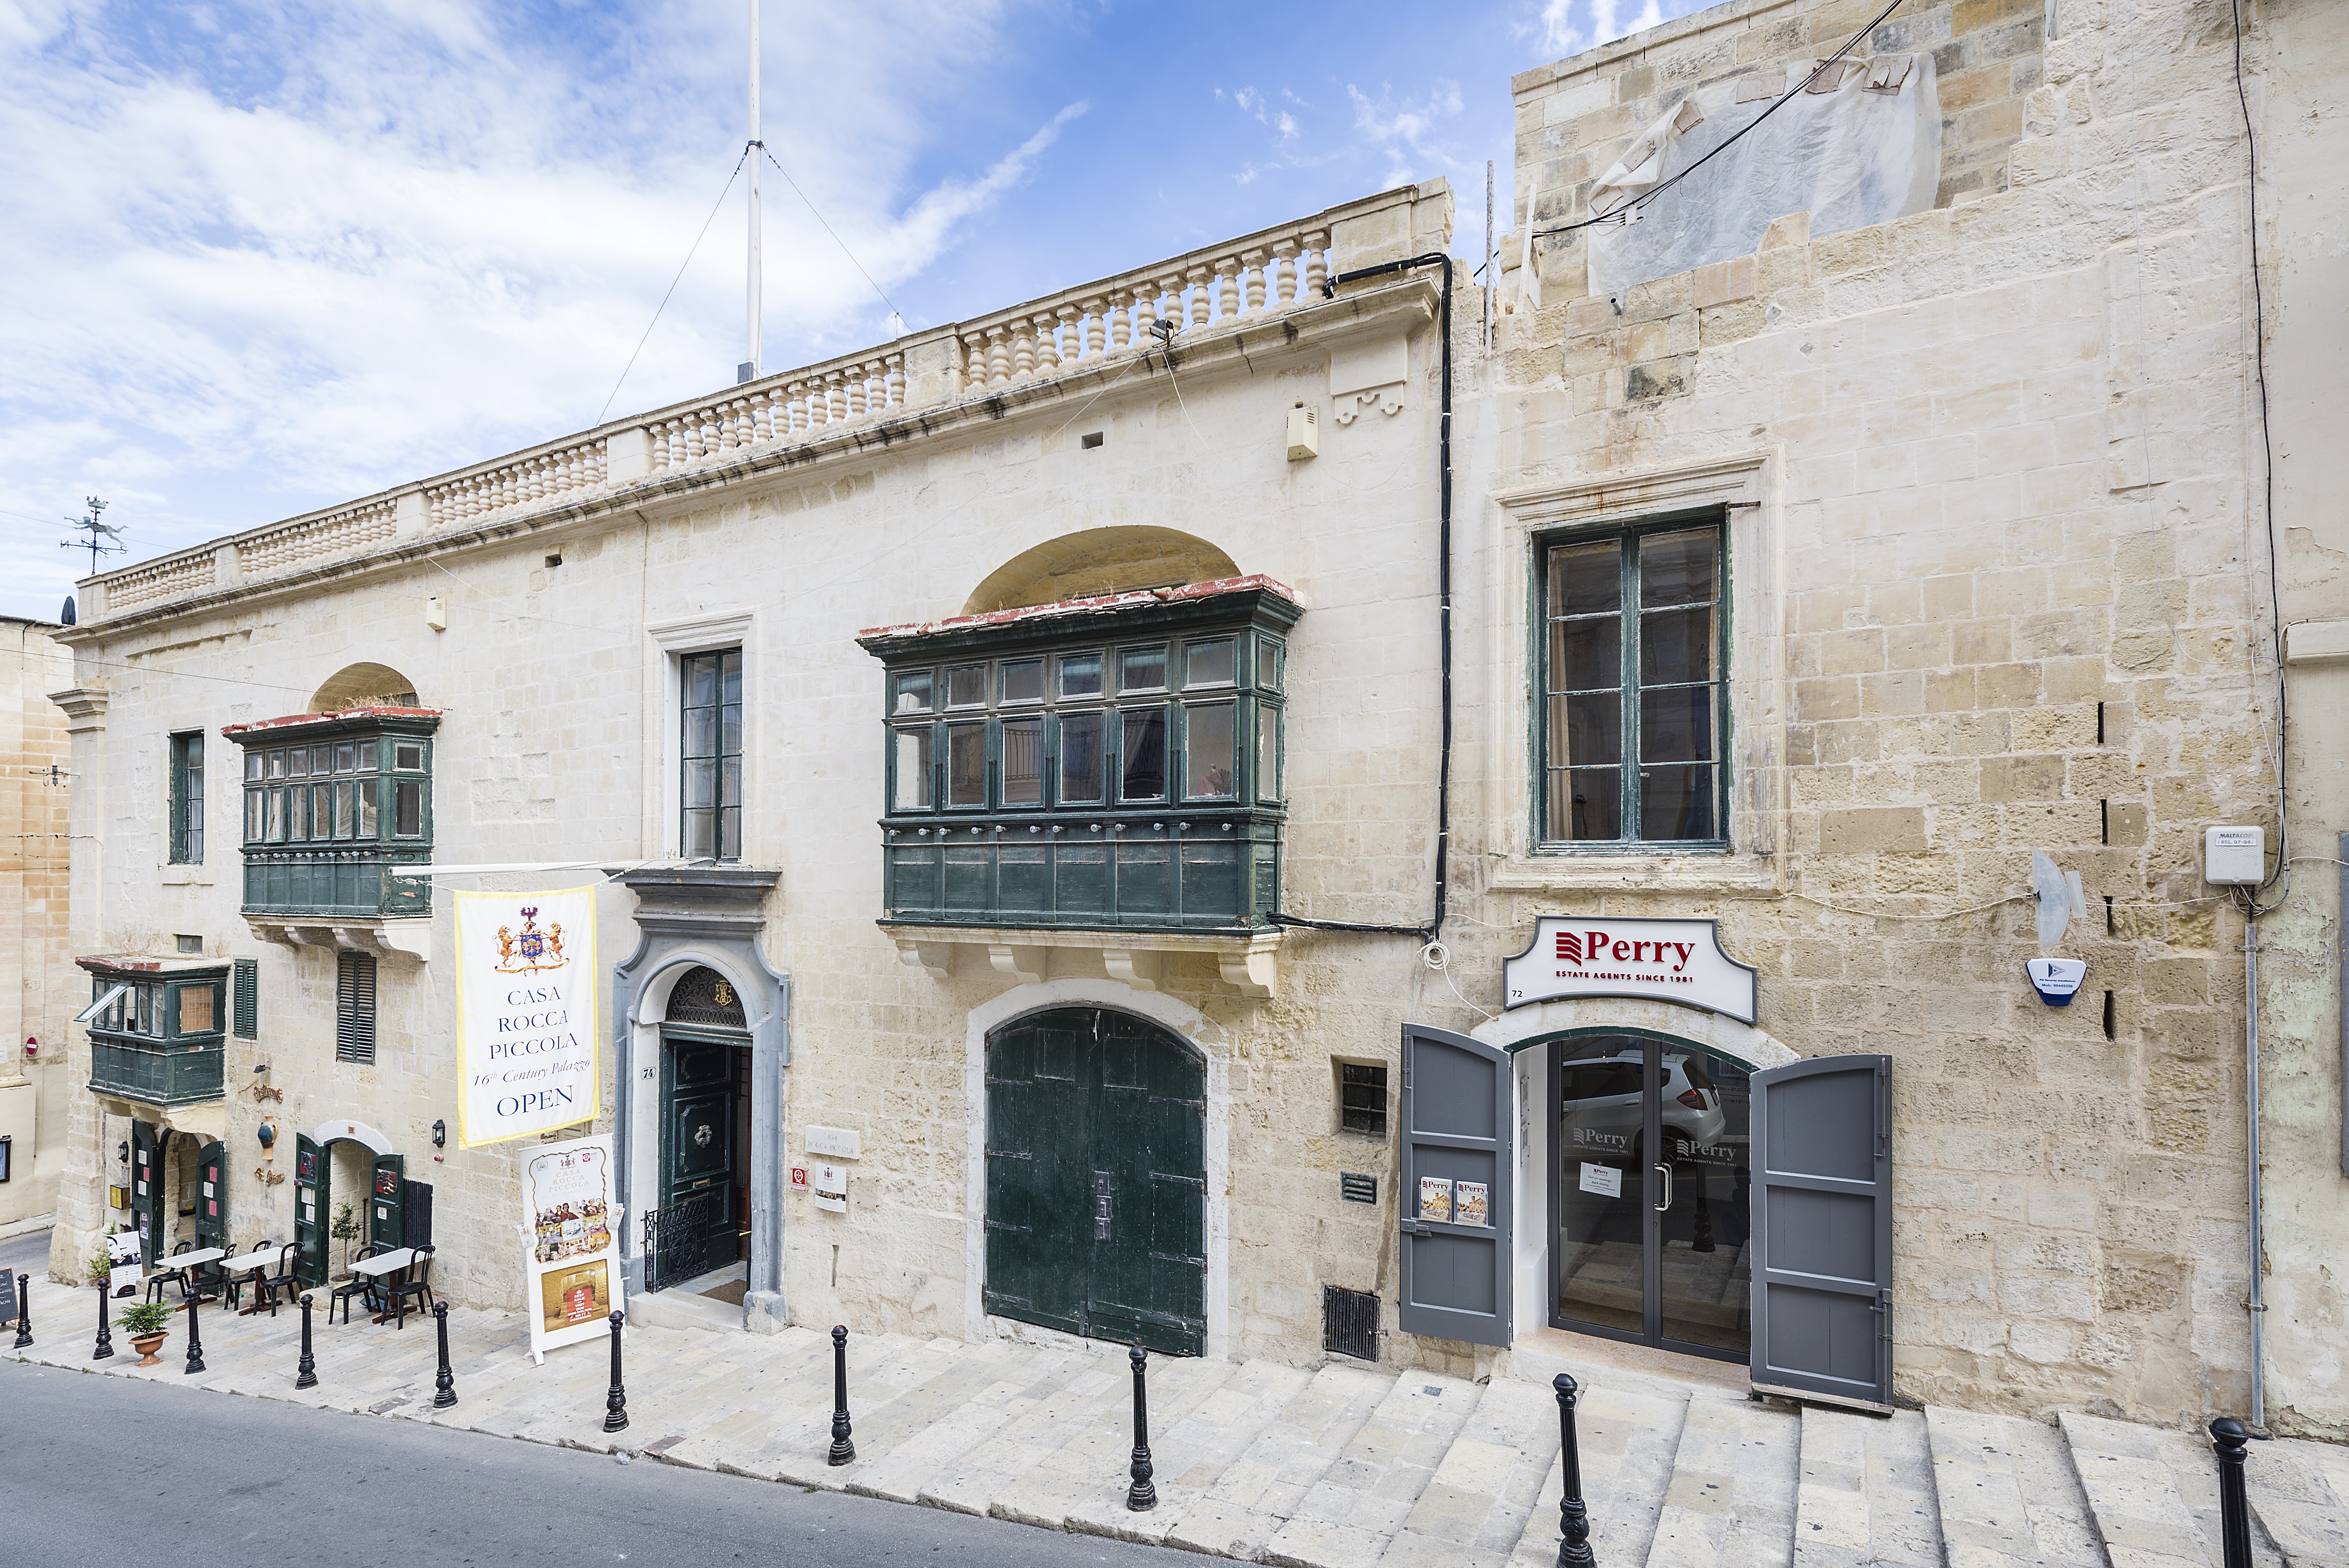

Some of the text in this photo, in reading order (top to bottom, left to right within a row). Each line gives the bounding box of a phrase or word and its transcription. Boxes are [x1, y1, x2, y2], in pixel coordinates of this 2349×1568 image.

[1584, 931, 1695, 971] Perry
[508, 986, 561, 1005] CASA
[497, 1010, 568, 1033] ROCCA
[489, 1033, 579, 1060] PICCOLA
[474, 1060, 590, 1086] 16th Century Palazzo
[643, 1068, 654, 1078] 74
[497, 1085, 574, 1116] OPEN
[1585, 1129, 1628, 1148] Perry
[1690, 1140, 1736, 1161] Perry
[553, 1175, 585, 1185] ROCCA
[556, 1169, 581, 1178] CASA
[549, 1180, 590, 1192] PICCOLA
[1428, 1181, 1449, 1191] Perry
[1464, 1185, 1486, 1194] Perry
